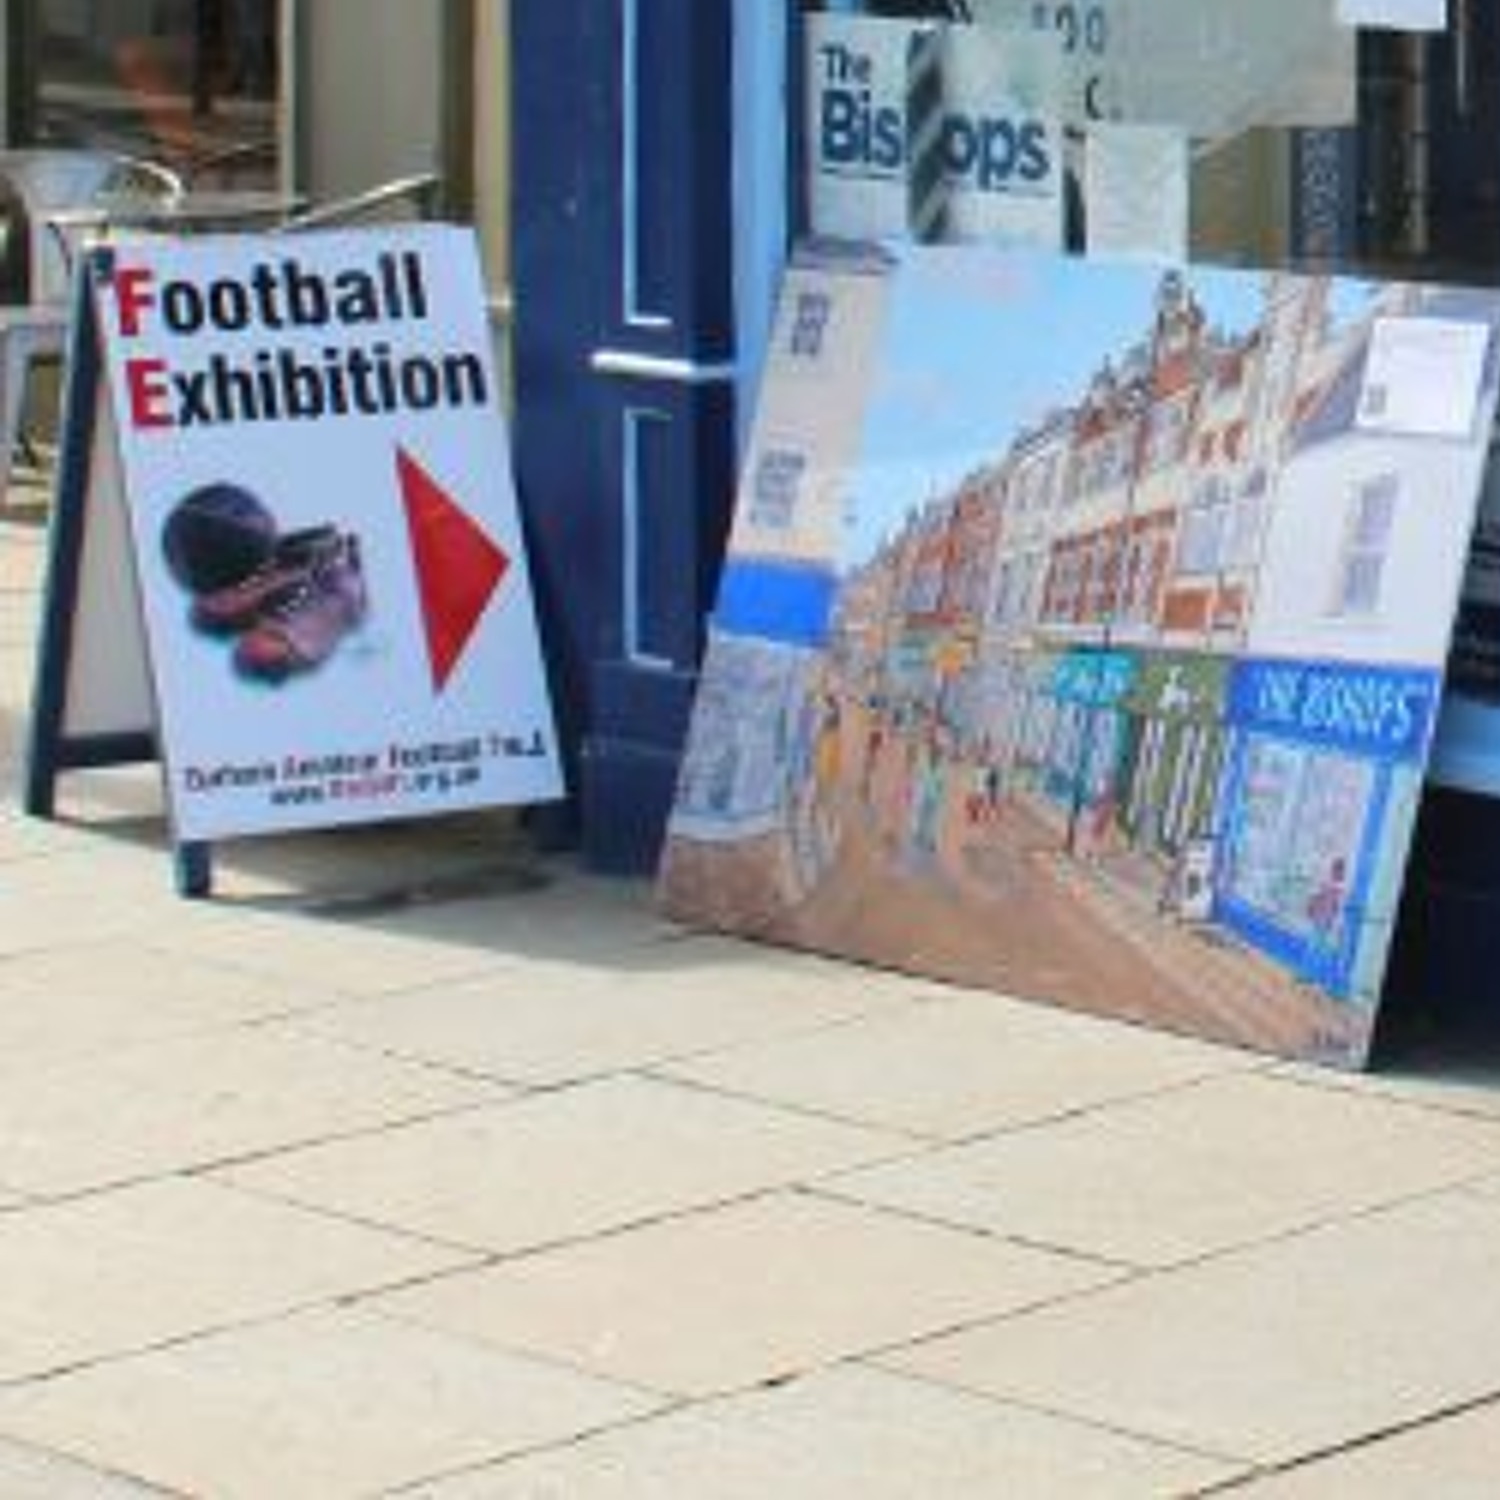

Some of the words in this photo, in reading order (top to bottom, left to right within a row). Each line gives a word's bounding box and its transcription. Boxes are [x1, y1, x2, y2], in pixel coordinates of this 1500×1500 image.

[818, 42, 872, 83] The
[821, 88, 1050, 193] Bisops
[113, 249, 428, 337] Football
[126, 342, 488, 428] Exhibition
